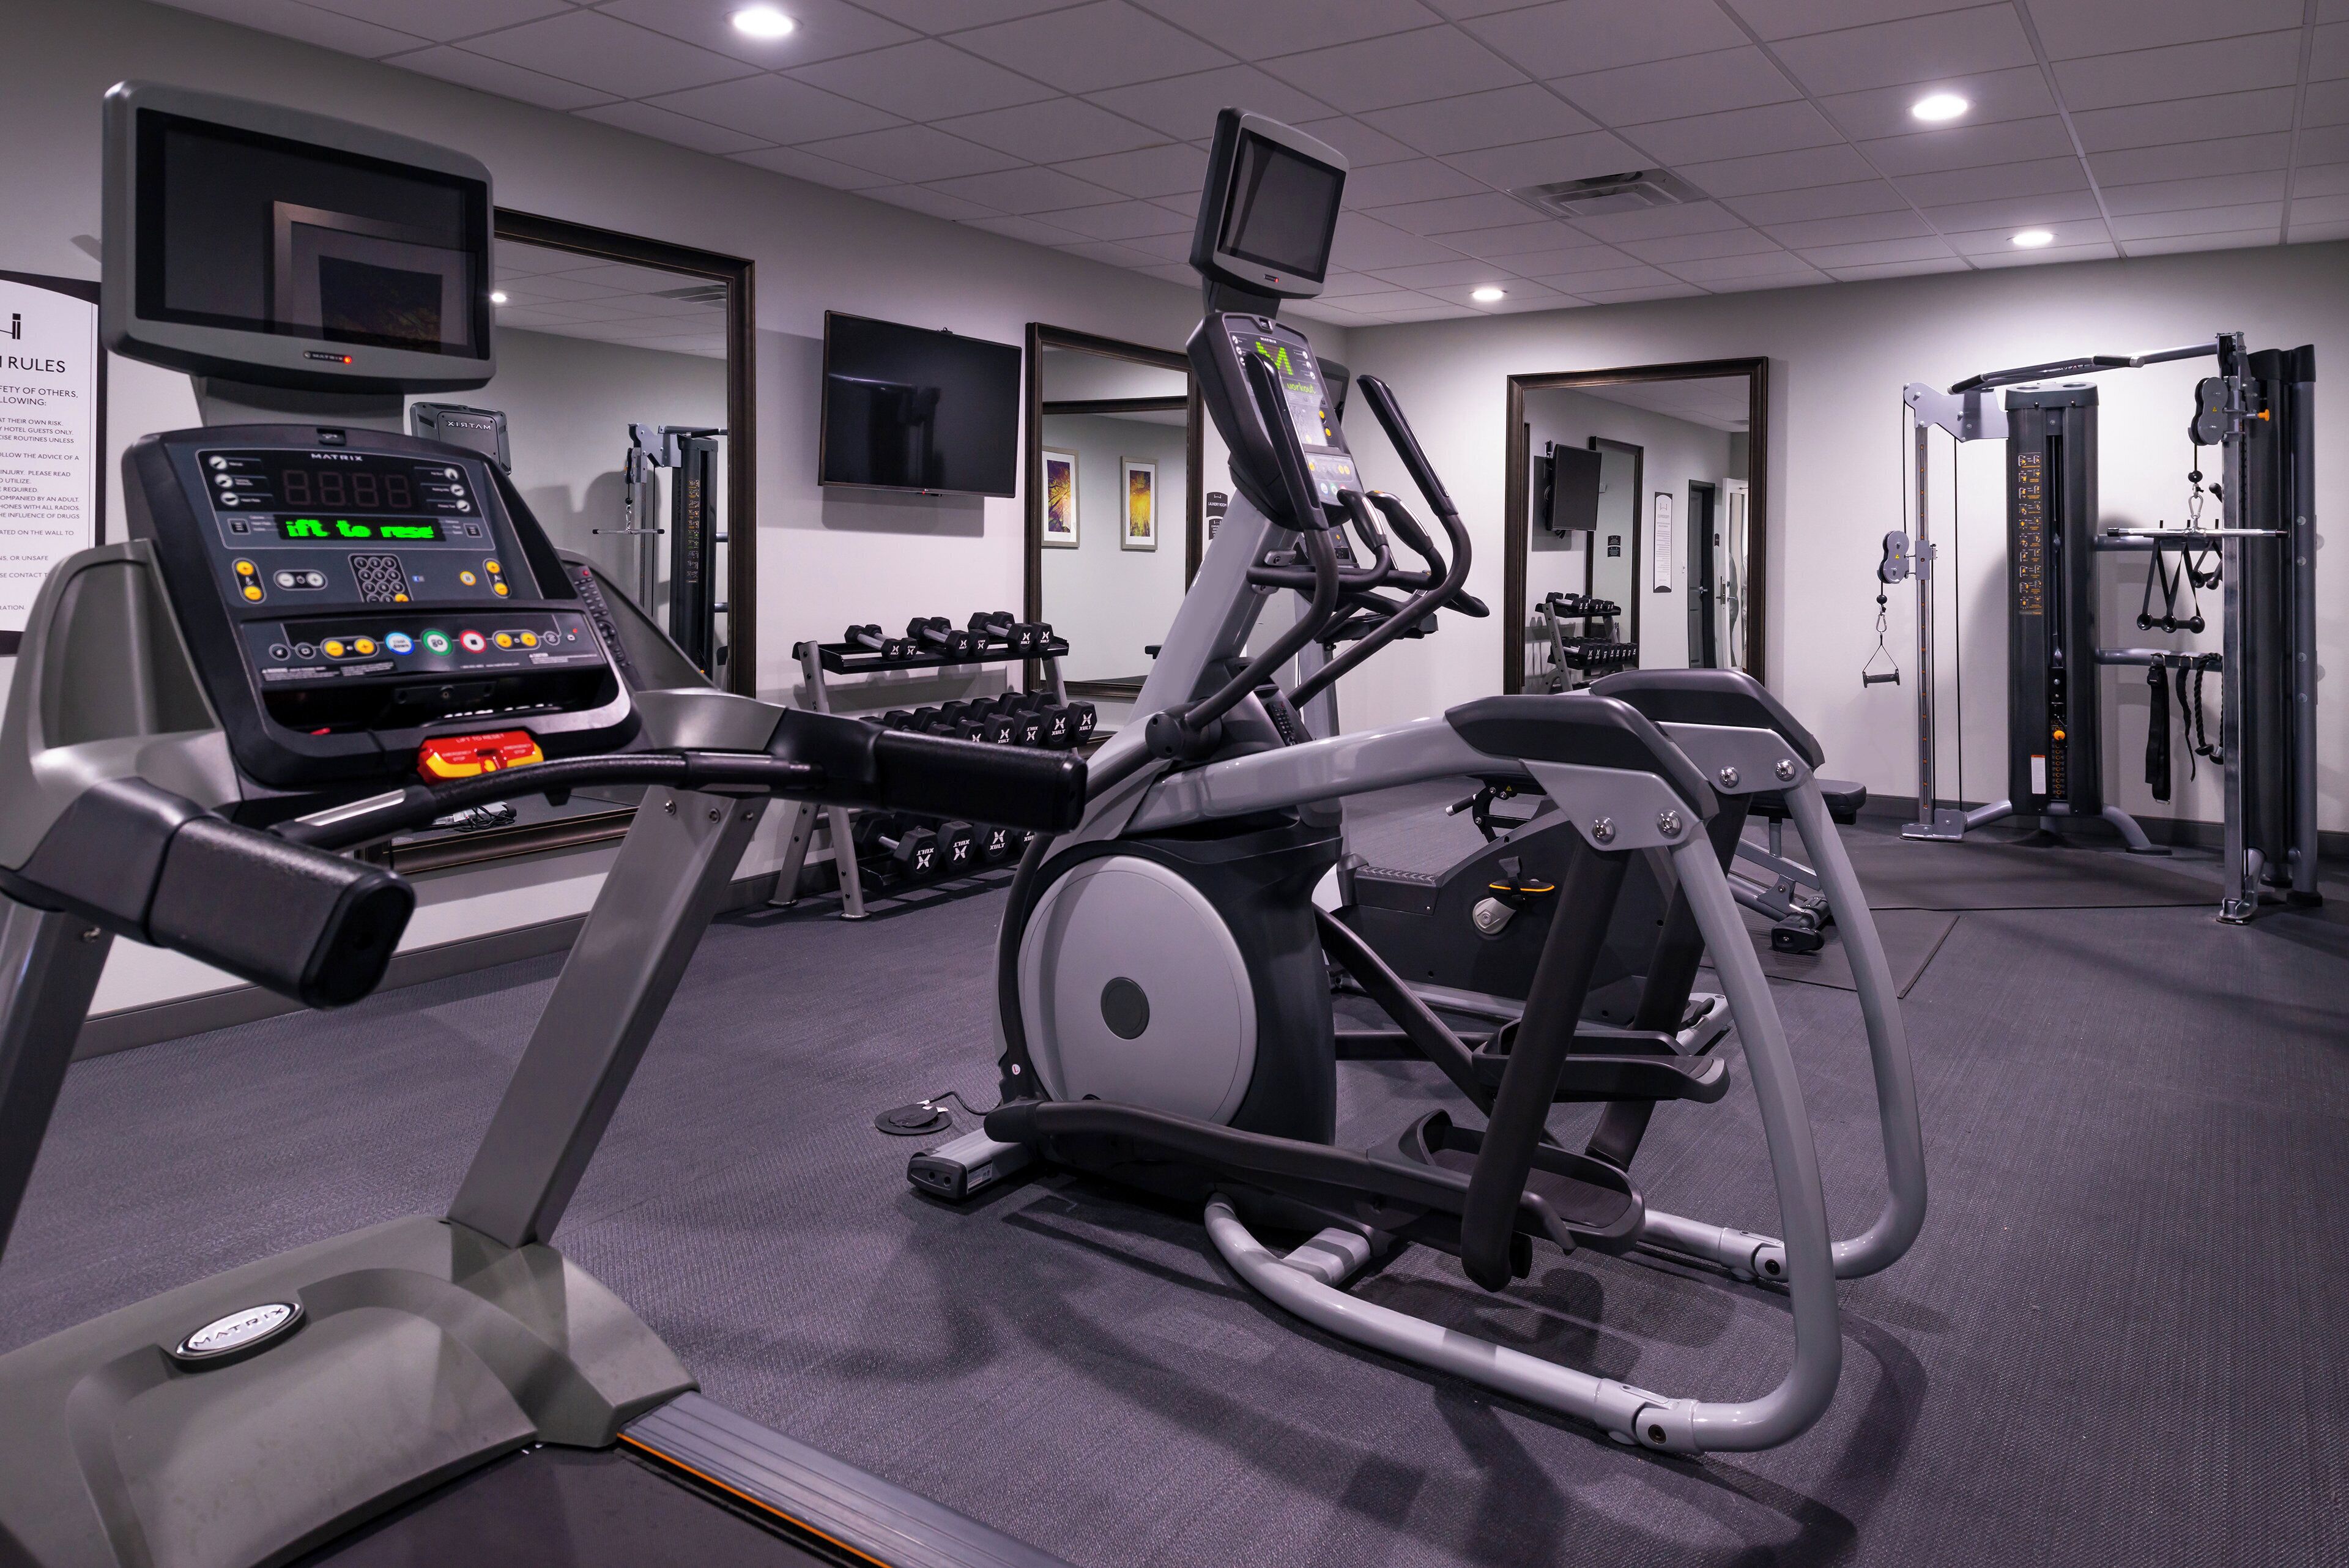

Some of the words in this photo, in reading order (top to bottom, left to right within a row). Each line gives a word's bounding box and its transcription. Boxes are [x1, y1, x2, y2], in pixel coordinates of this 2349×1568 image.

[8, 356, 65, 373] RULES
[38, 388, 78, 398] OTHERS,
[0, 396, 47, 406] LOWING:
[336, 520, 372, 538] to
[952, 839, 970, 848] XULT
[989, 842, 1006, 850] XULT
[916, 847, 935, 856] XULT
[194, 1307, 284, 1347] MATRIX
